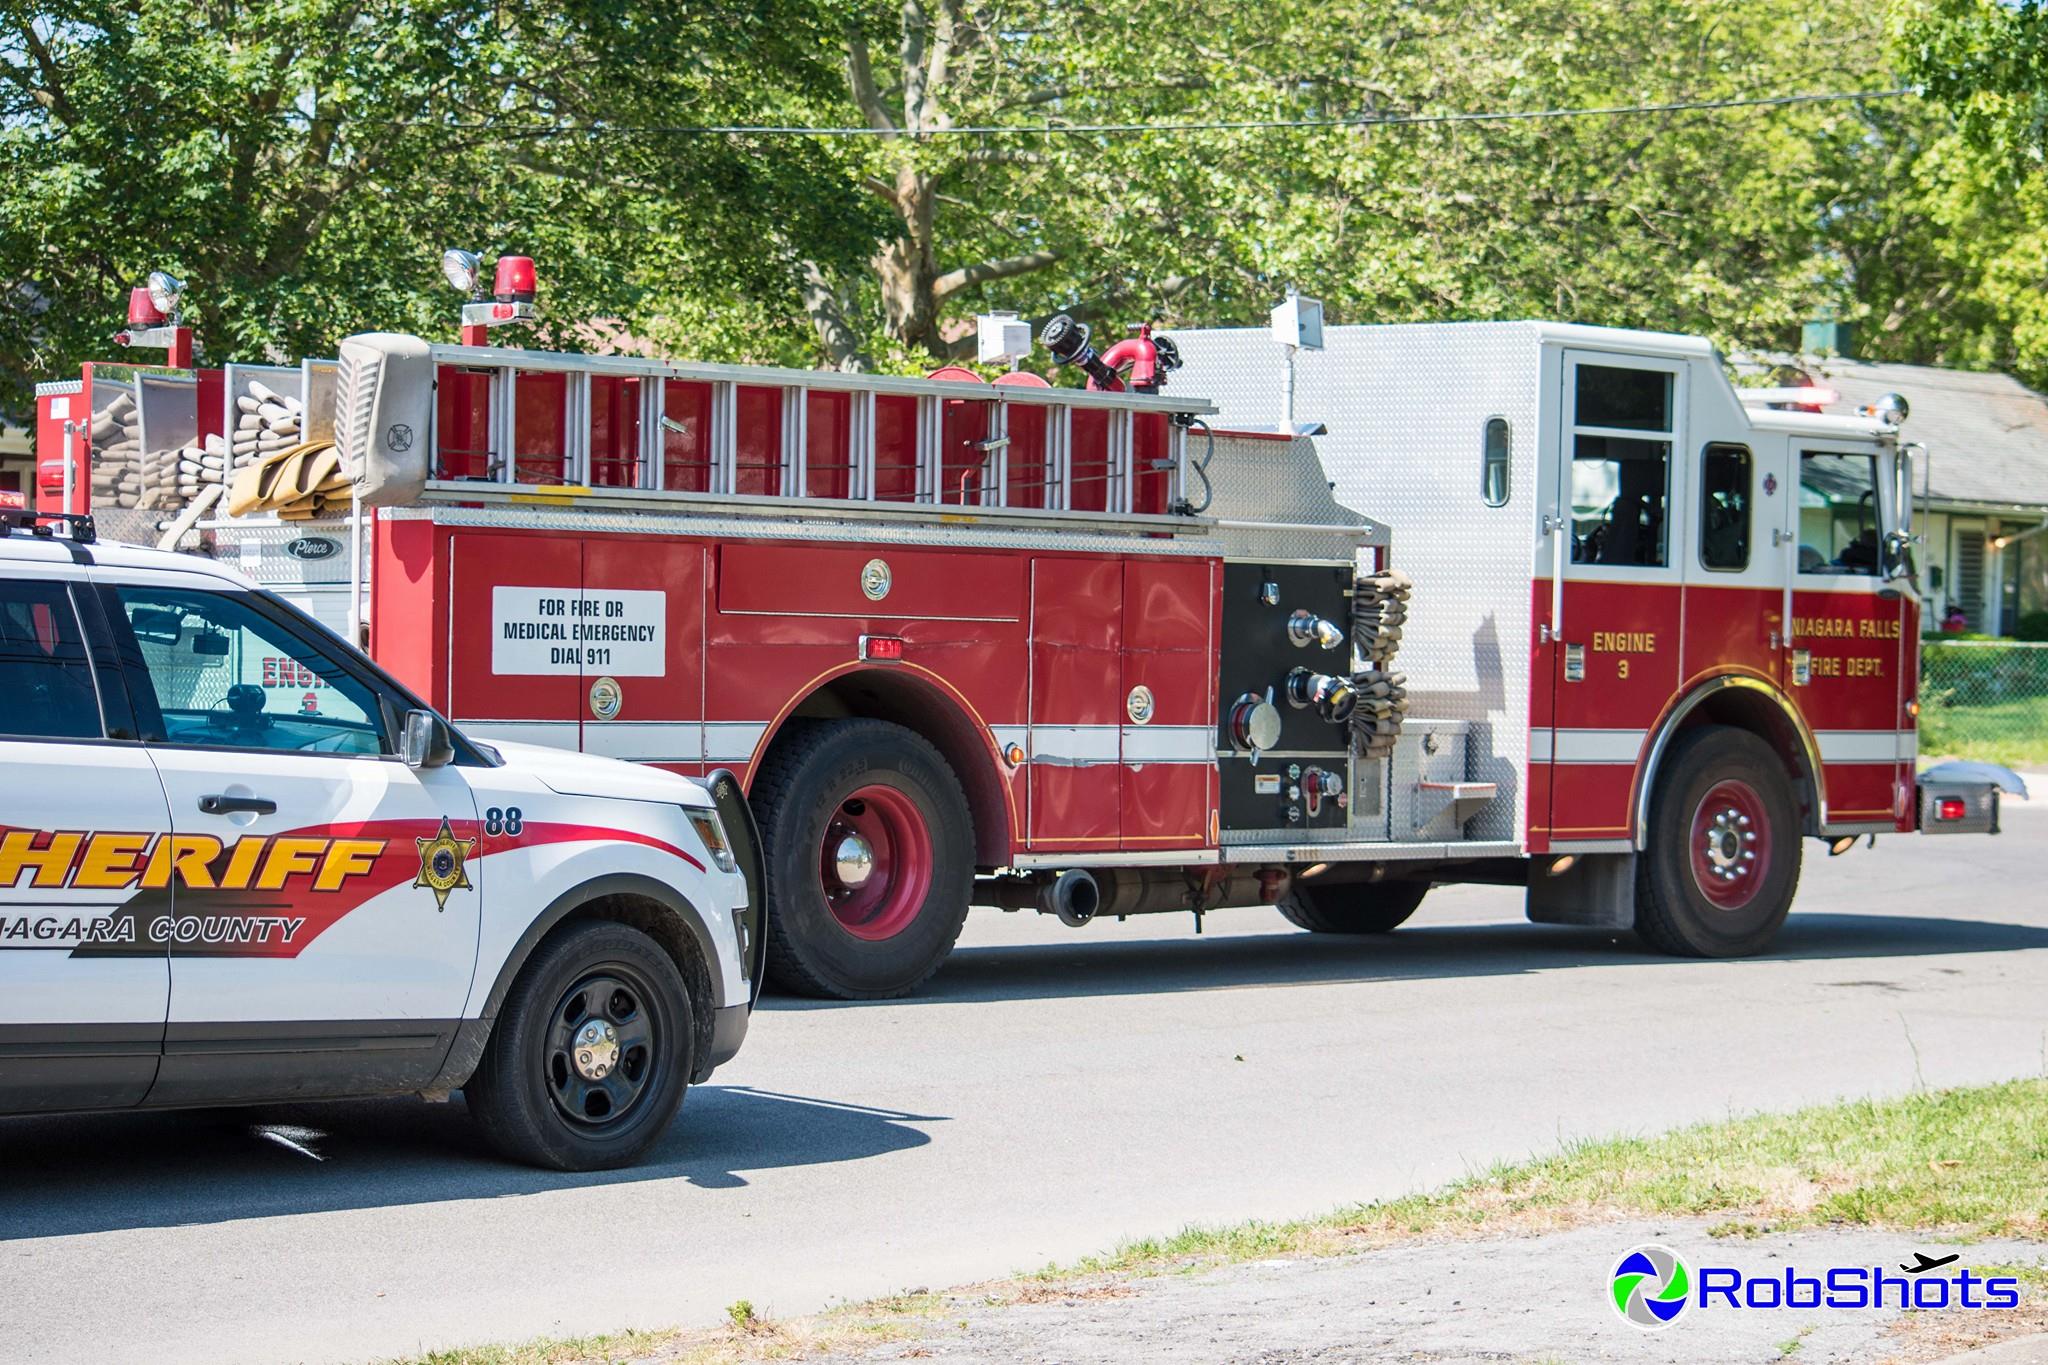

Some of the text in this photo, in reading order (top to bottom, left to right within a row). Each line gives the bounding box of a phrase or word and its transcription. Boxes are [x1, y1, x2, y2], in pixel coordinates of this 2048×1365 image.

[295, 538, 328, 557] Pierce
[539, 599, 623, 617] FOR FIRE OR
[504, 622, 655, 642] MEDICAL EMERGENCY
[1791, 617, 1900, 639] NIAGARA FALLS
[1593, 631, 1655, 653] ENGINE
[551, 647, 610, 665] DIAL 911
[1810, 656, 1884, 677] FIRE DEPT.
[262, 657, 332, 688] ENG
[1618, 659, 1629, 680] 3
[485, 806, 523, 837] 88
[149, 916, 306, 943] COUNTY
